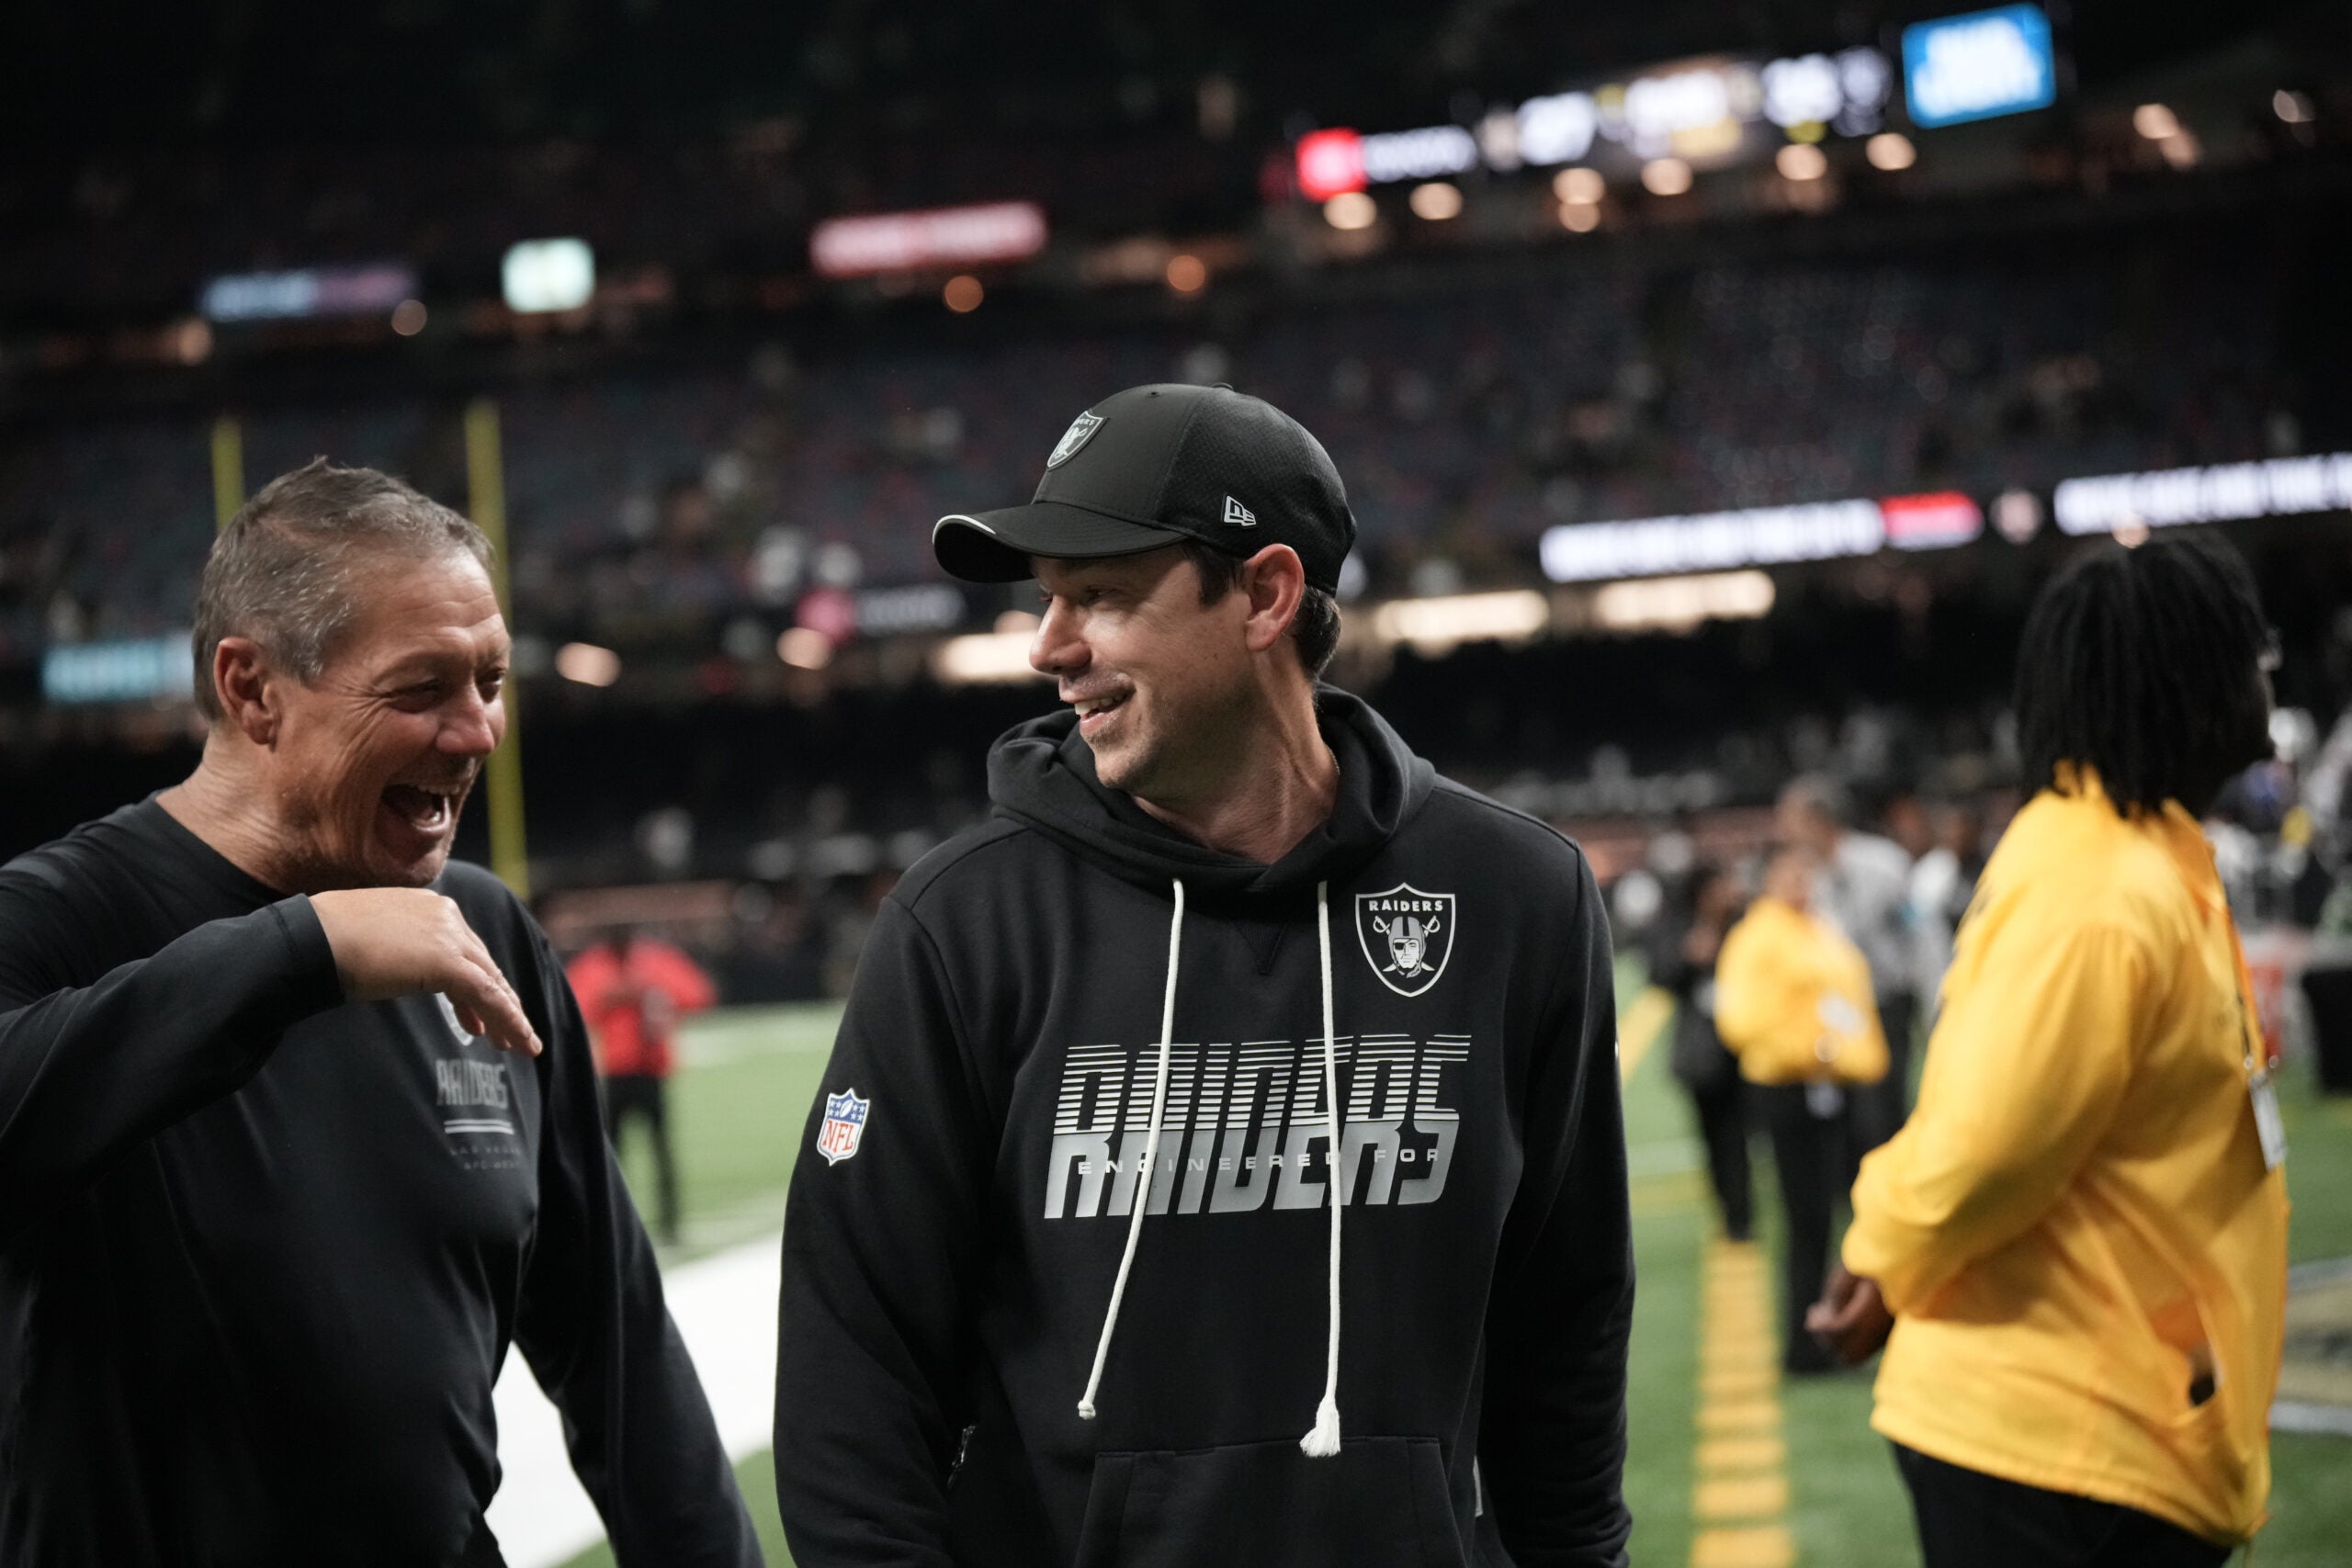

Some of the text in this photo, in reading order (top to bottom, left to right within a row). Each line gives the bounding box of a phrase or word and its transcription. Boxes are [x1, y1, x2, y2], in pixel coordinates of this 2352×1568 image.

[1368, 899, 1443, 912] RAIDERS
[822, 1119, 854, 1153] NFL
[1044, 1033, 1471, 1219] RAIDERS
[1374, 1148, 1439, 1163] FOR
